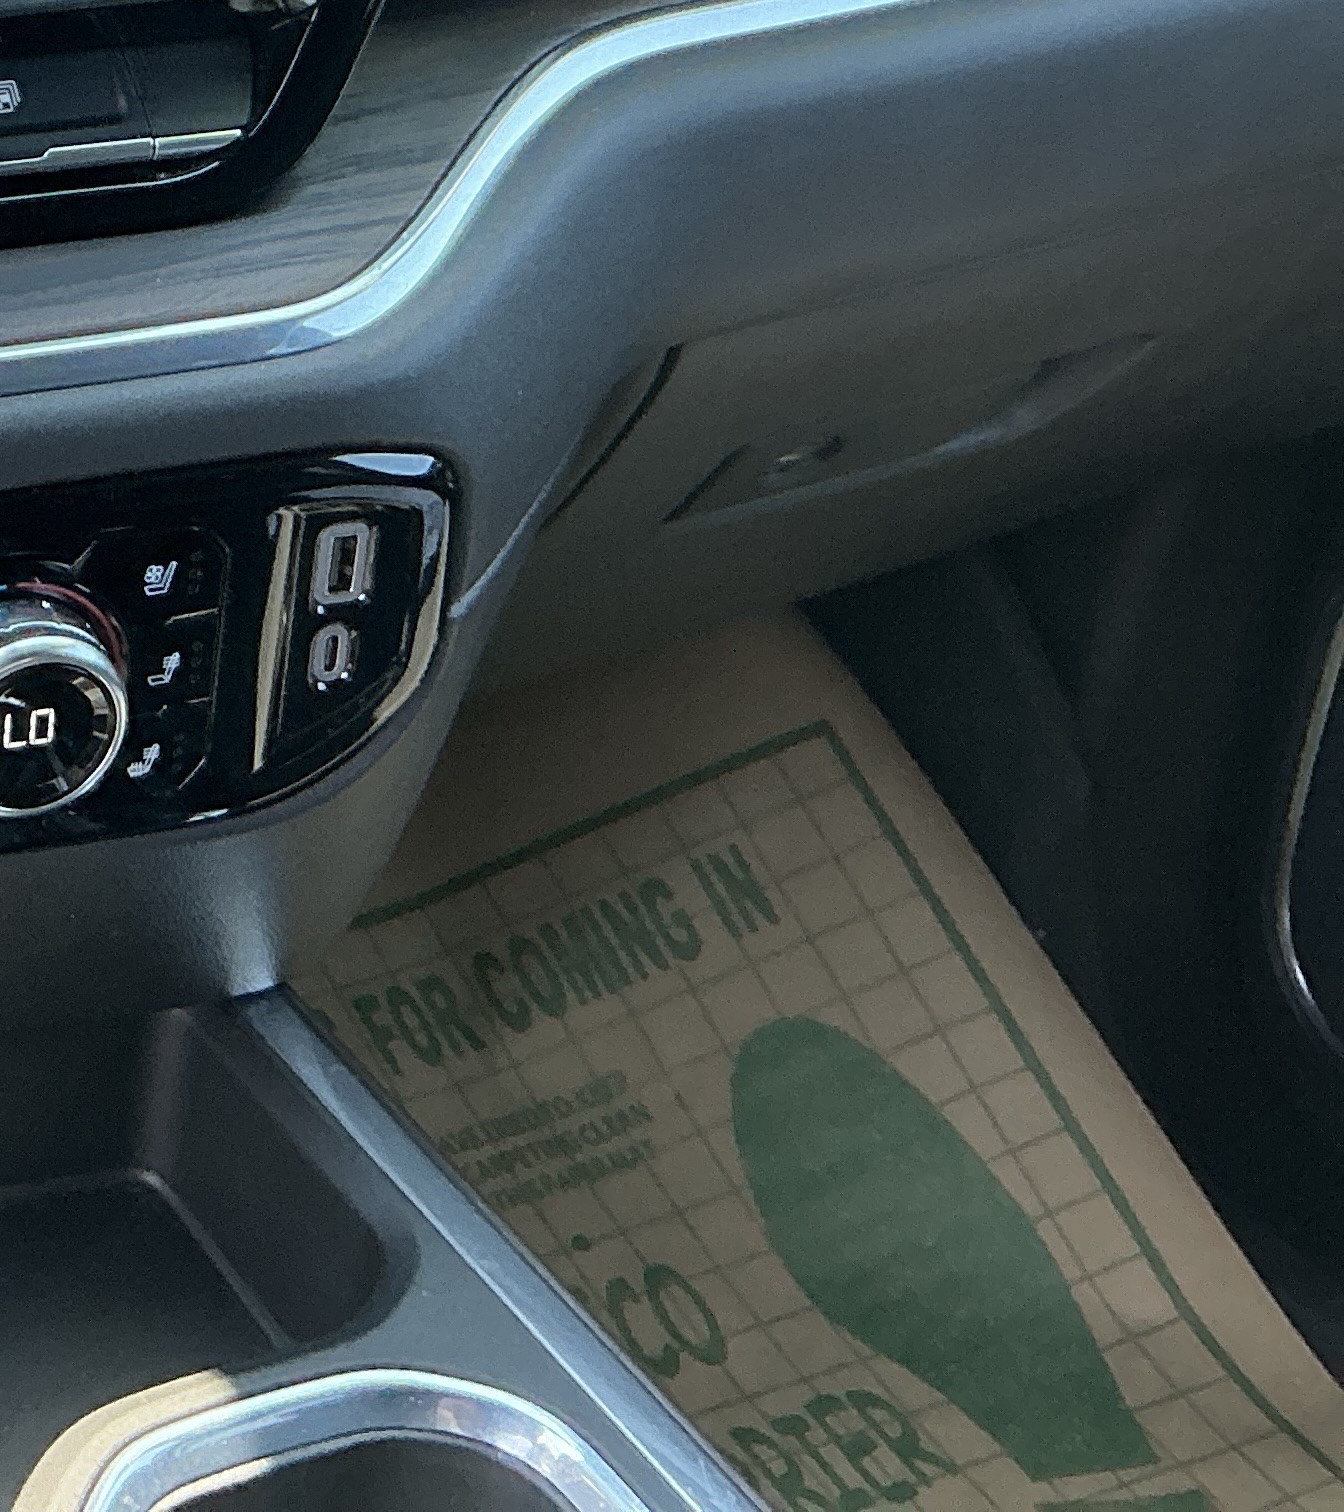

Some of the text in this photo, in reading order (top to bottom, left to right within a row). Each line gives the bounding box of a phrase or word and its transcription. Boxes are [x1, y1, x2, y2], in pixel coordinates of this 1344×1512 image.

[352, 843, 779, 1076] FOR COMING IN
